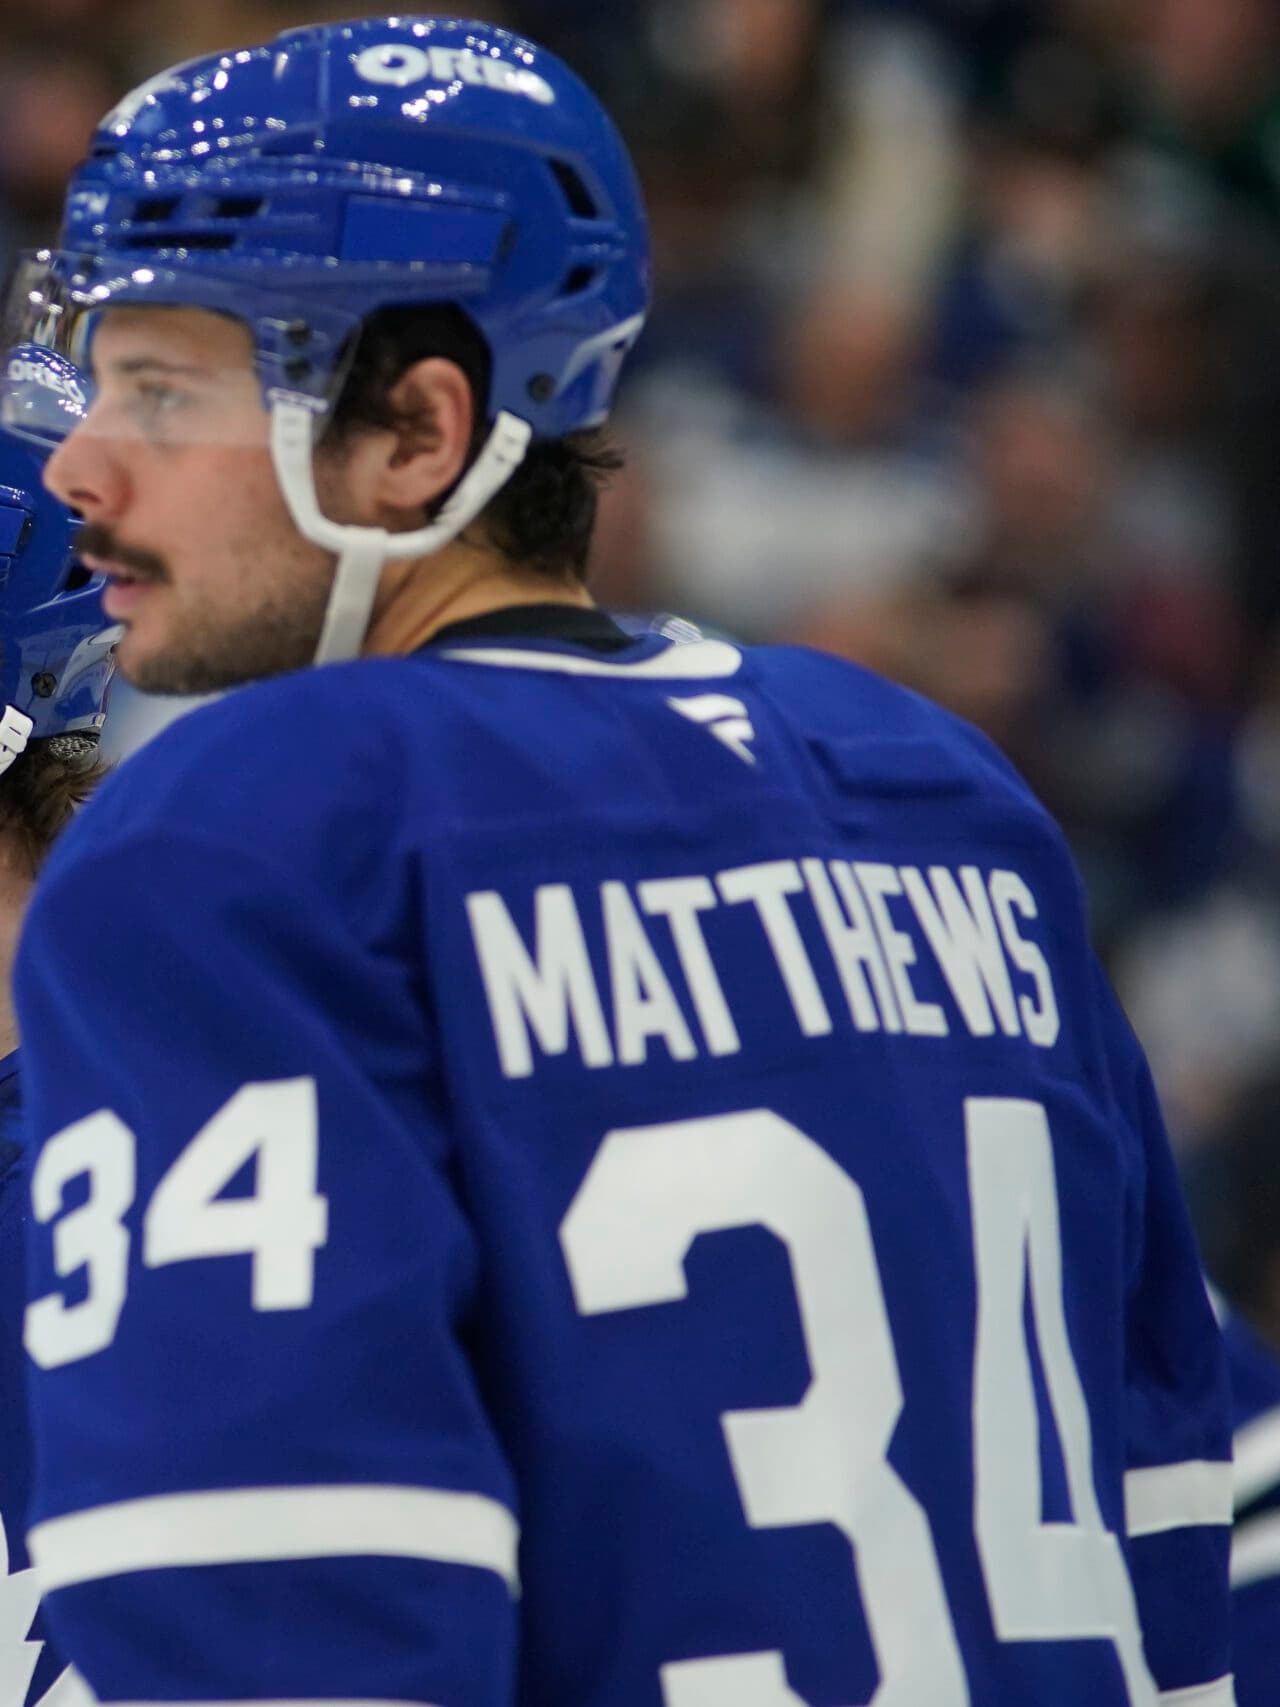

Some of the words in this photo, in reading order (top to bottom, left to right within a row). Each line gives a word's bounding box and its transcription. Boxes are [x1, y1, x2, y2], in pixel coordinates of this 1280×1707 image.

[467, 858, 1060, 1078] MATTHEWS
[23, 1075, 328, 1370] 34
[558, 1097, 1160, 1707] 34
